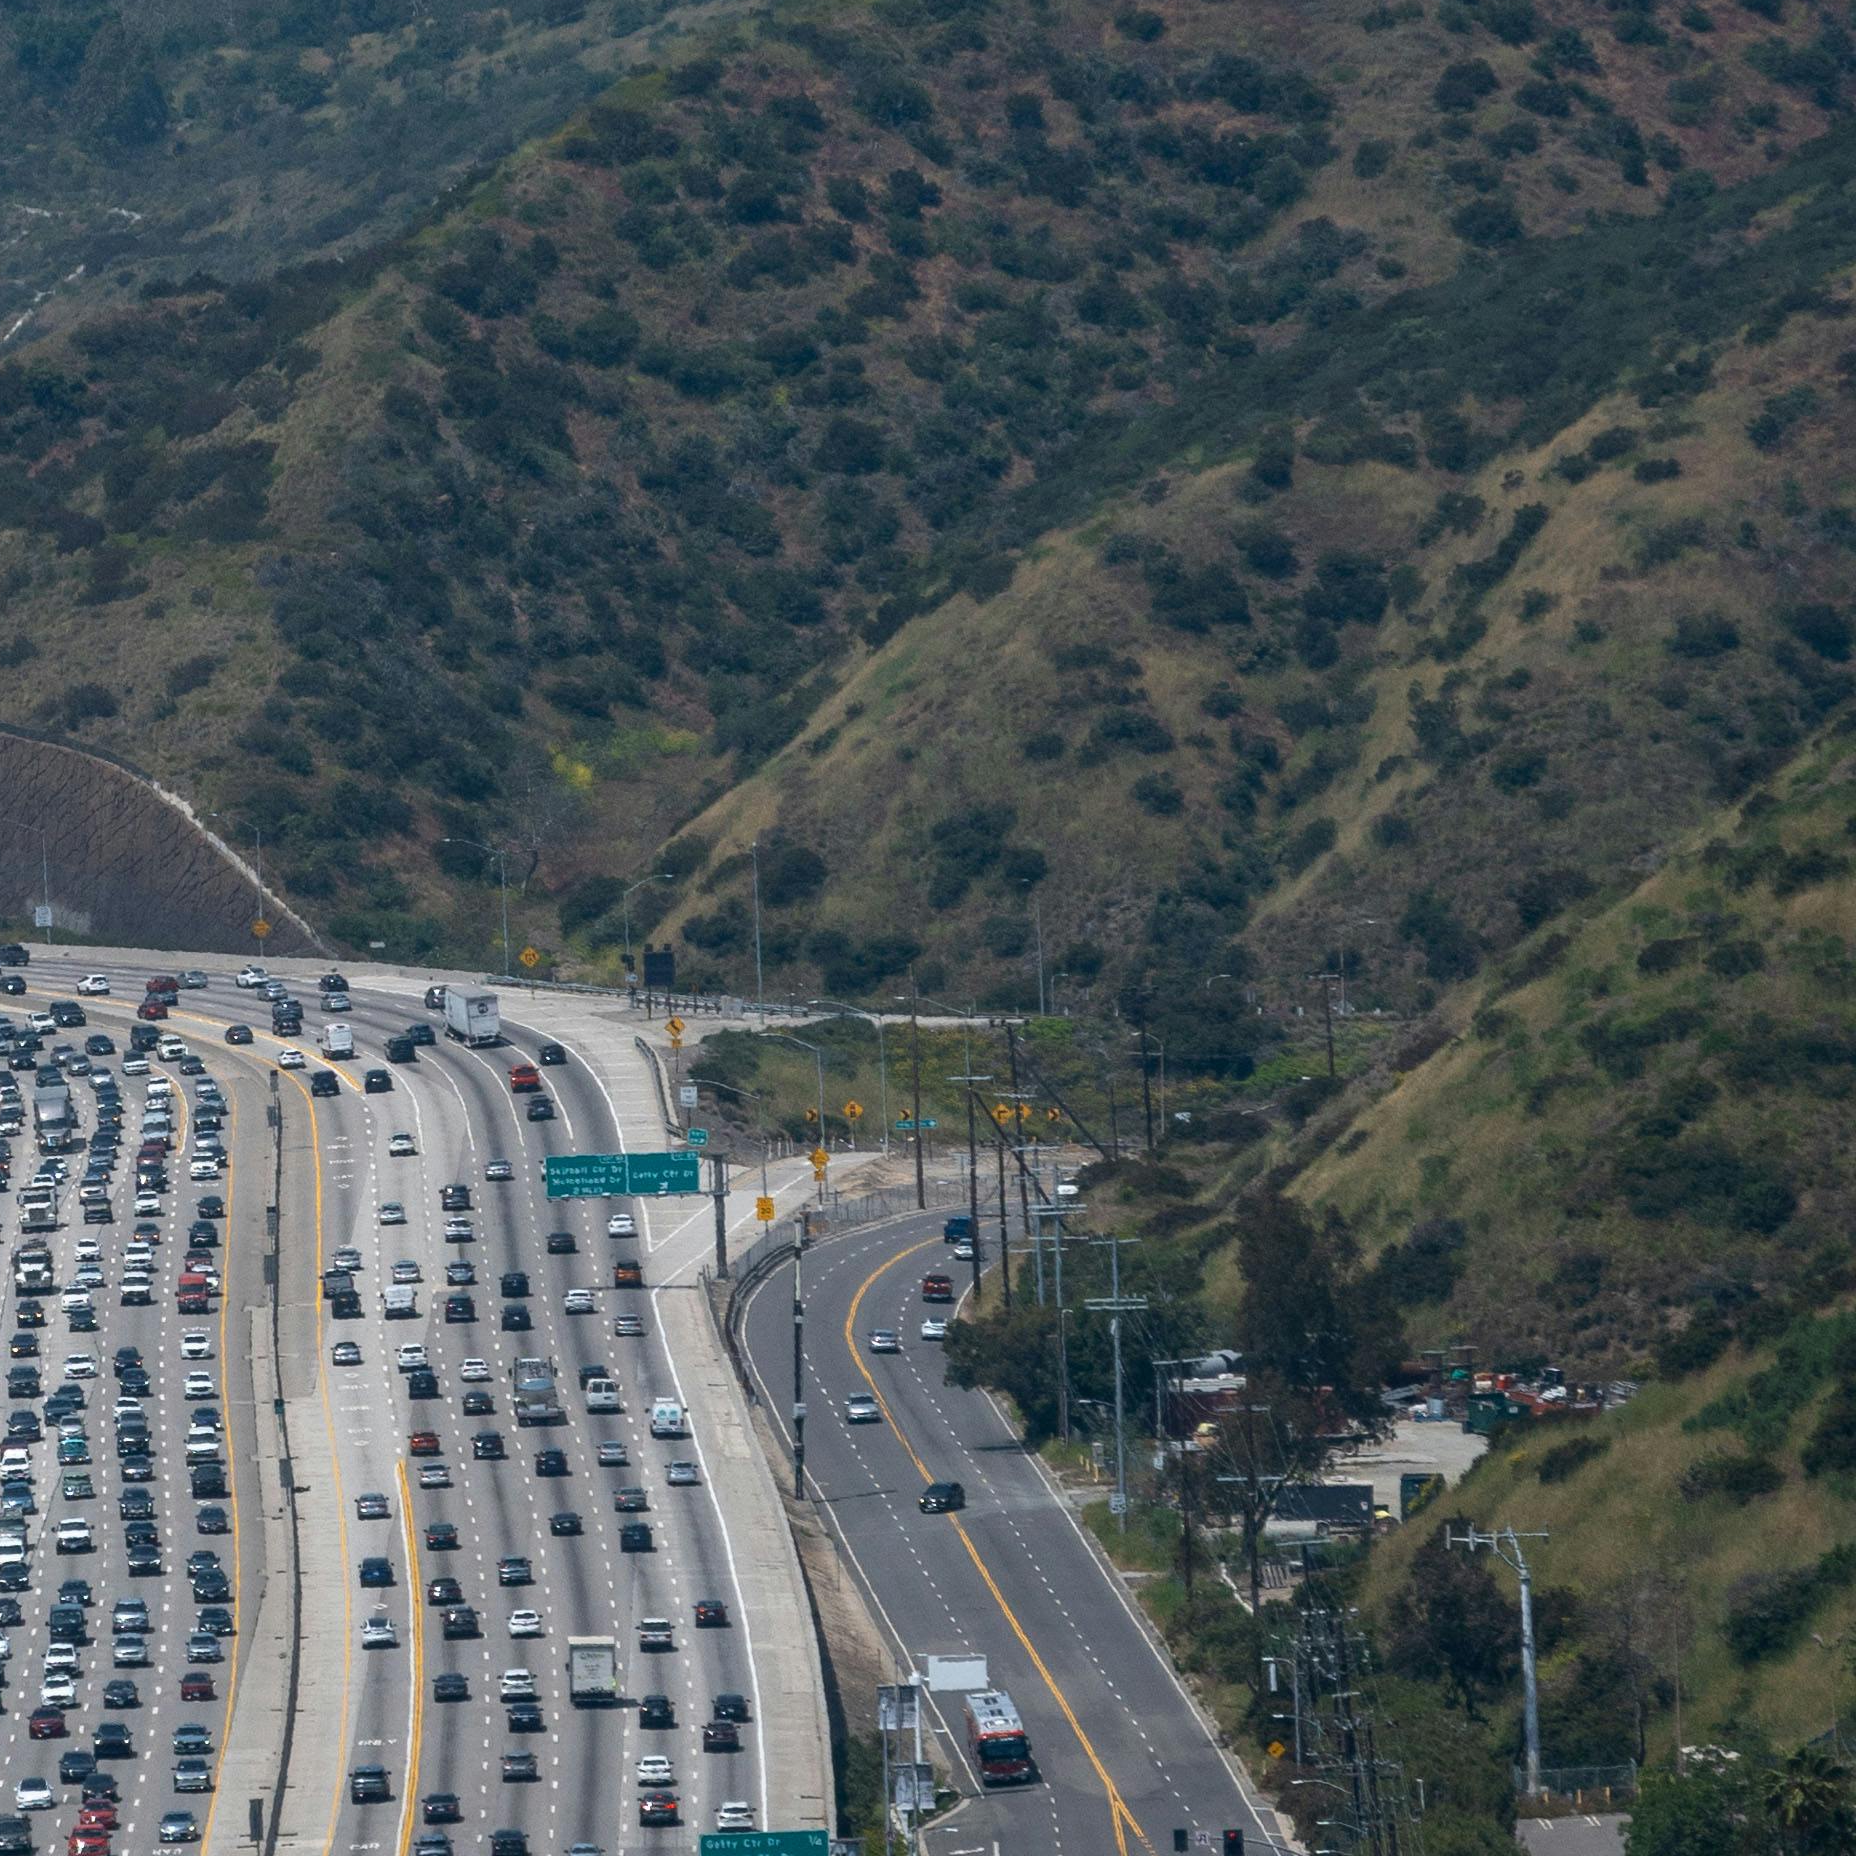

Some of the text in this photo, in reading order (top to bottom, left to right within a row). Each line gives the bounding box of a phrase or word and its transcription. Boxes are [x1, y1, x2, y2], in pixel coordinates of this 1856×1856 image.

[706, 1837, 781, 1849] Getty Ctr Dr
